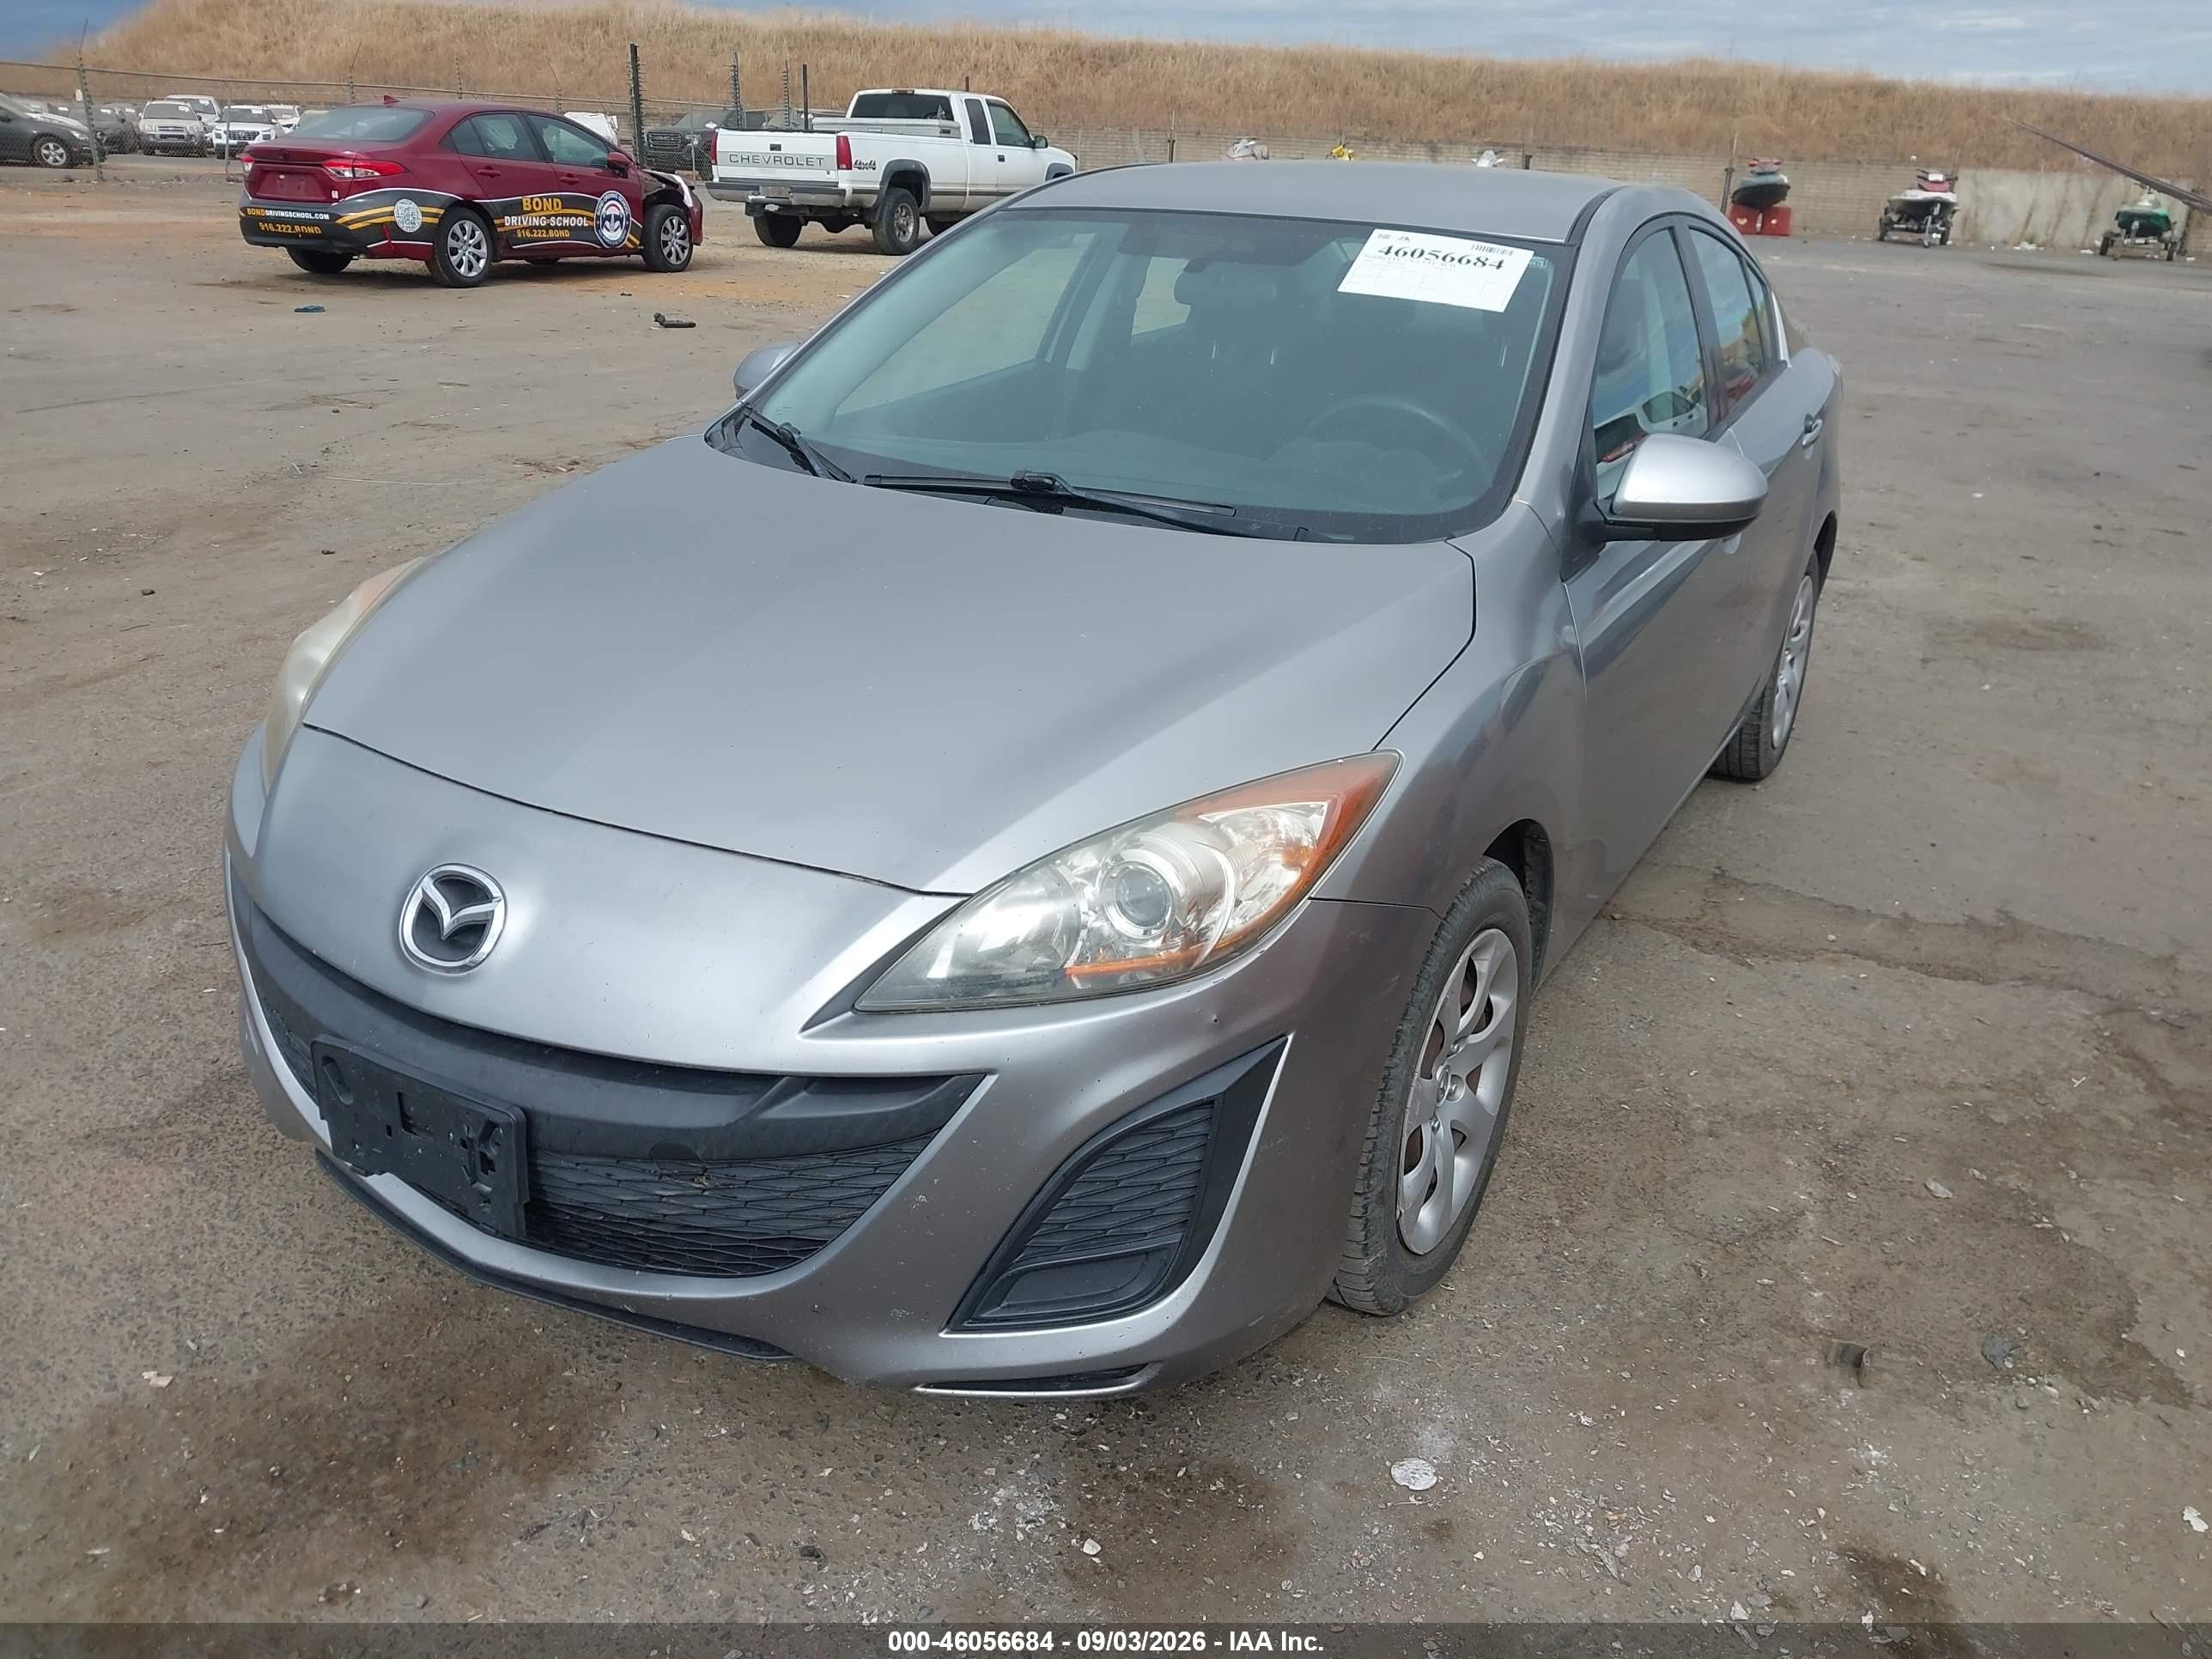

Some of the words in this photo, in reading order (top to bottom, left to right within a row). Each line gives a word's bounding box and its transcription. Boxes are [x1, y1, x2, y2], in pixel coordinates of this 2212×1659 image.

[729, 153, 825, 167] CHEVROLET
[854, 158, 878, 171] 4x4
[522, 197, 563, 212] BOND
[504, 216, 547, 227] DRIVING
[550, 217, 589, 227] SCHOOL
[516, 228, 570, 238] 916.222.BOND
[1378, 245, 1504, 270] 46056684
